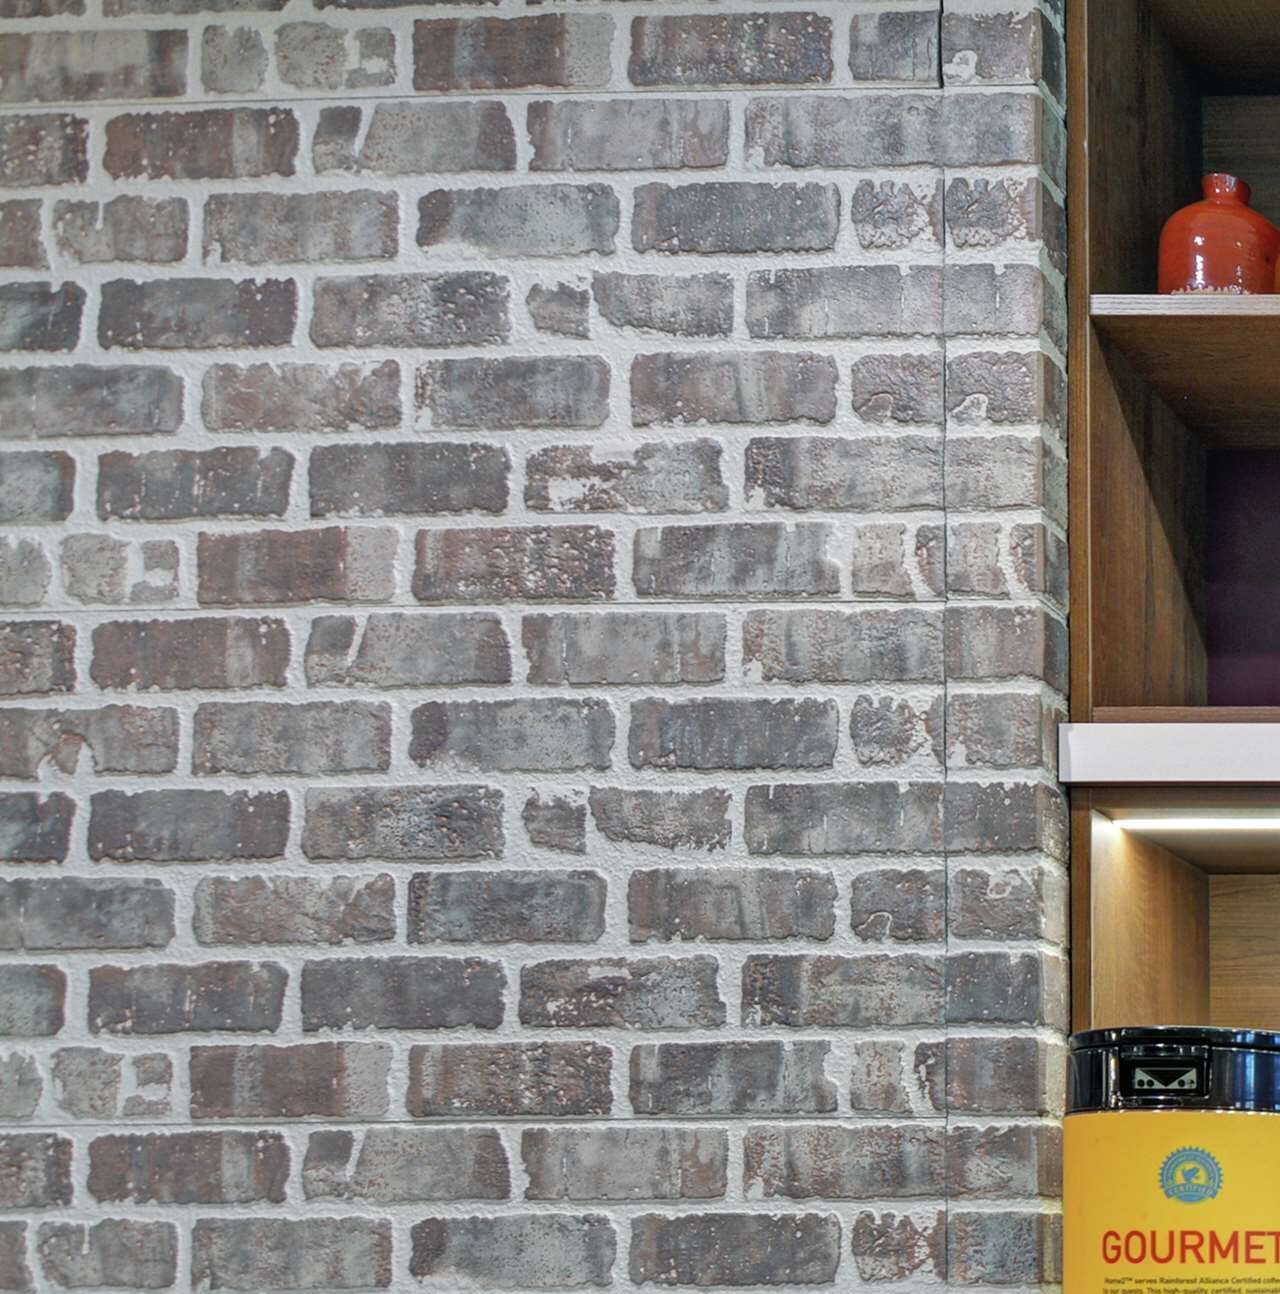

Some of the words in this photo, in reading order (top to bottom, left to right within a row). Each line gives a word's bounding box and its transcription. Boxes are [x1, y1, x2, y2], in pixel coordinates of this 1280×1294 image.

[1134, 1277, 1157, 1285] serves
[1159, 1277, 1197, 1285] Rainforest
[1199, 1277, 1229, 1285] Alliance
[1231, 1277, 1262, 1285] Certified
